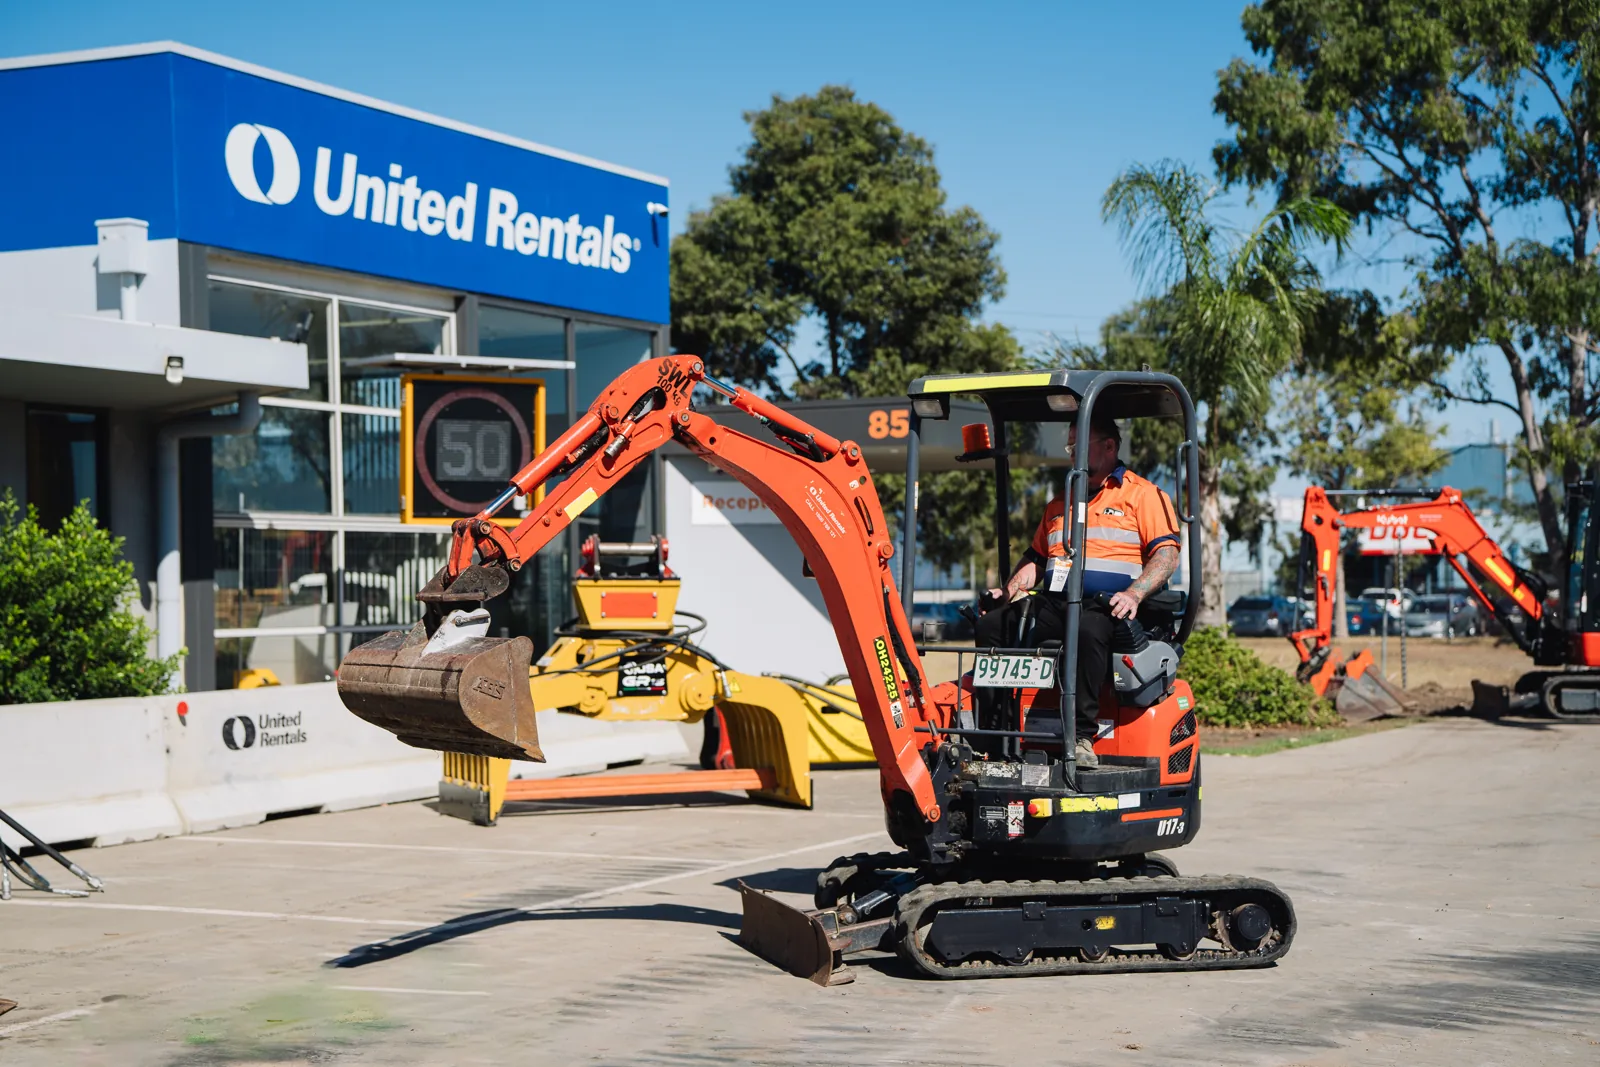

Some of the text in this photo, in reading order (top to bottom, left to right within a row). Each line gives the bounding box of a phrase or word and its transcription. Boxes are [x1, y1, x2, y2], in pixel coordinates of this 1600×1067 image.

[313, 146, 631, 274] United Rentals
[656, 375, 673, 393] 100
[658, 358, 691, 399] SWL
[868, 409, 910, 439] 85
[442, 423, 509, 477] 50
[805, 499, 814, 511] CALL
[815, 494, 846, 534] United Rentals
[875, 639, 899, 700] OH24225
[258, 710, 302, 730] United
[259, 728, 308, 748] Rentals
